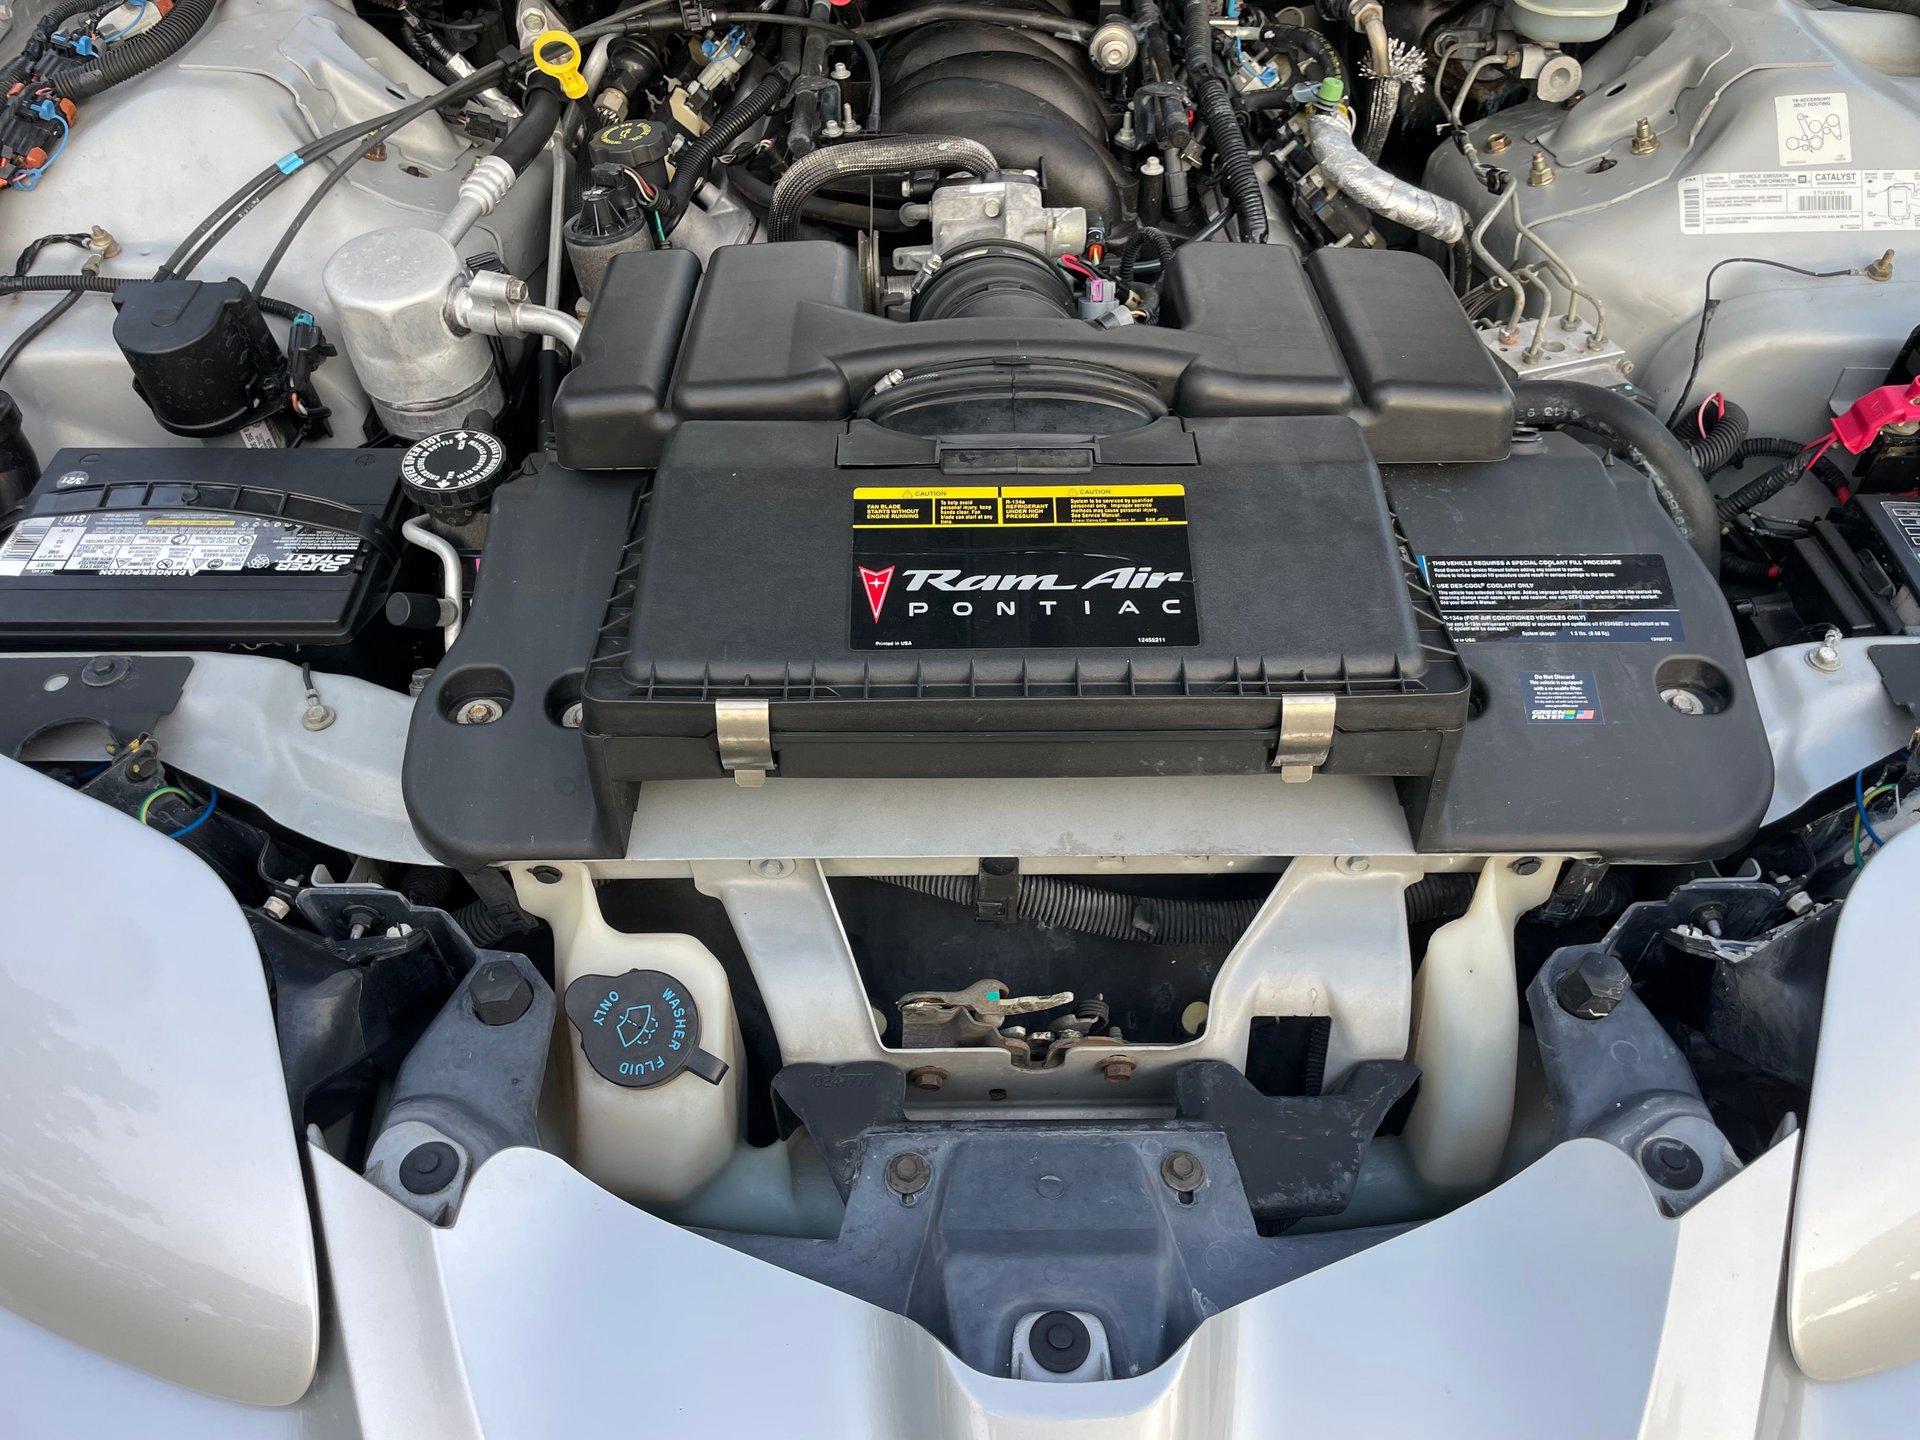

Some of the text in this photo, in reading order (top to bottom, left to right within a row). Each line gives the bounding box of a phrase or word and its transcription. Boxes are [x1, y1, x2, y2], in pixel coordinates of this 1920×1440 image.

[427, 439, 454, 452] BOTTLE
[404, 434, 441, 486] NEVER OPEN HOT
[62, 476, 84, 485] 3/21
[420, 469, 440, 481] CHECK
[458, 474, 482, 487] ALIGN
[274, 561, 342, 572] SUPER
[286, 553, 356, 565] START
[902, 566, 1184, 592] Ram Air
[908, 599, 1182, 617] PONTIAC
[593, 990, 619, 1027] ONLY
[662, 987, 687, 1050] WASHER
[619, 1055, 666, 1076] FLUID
